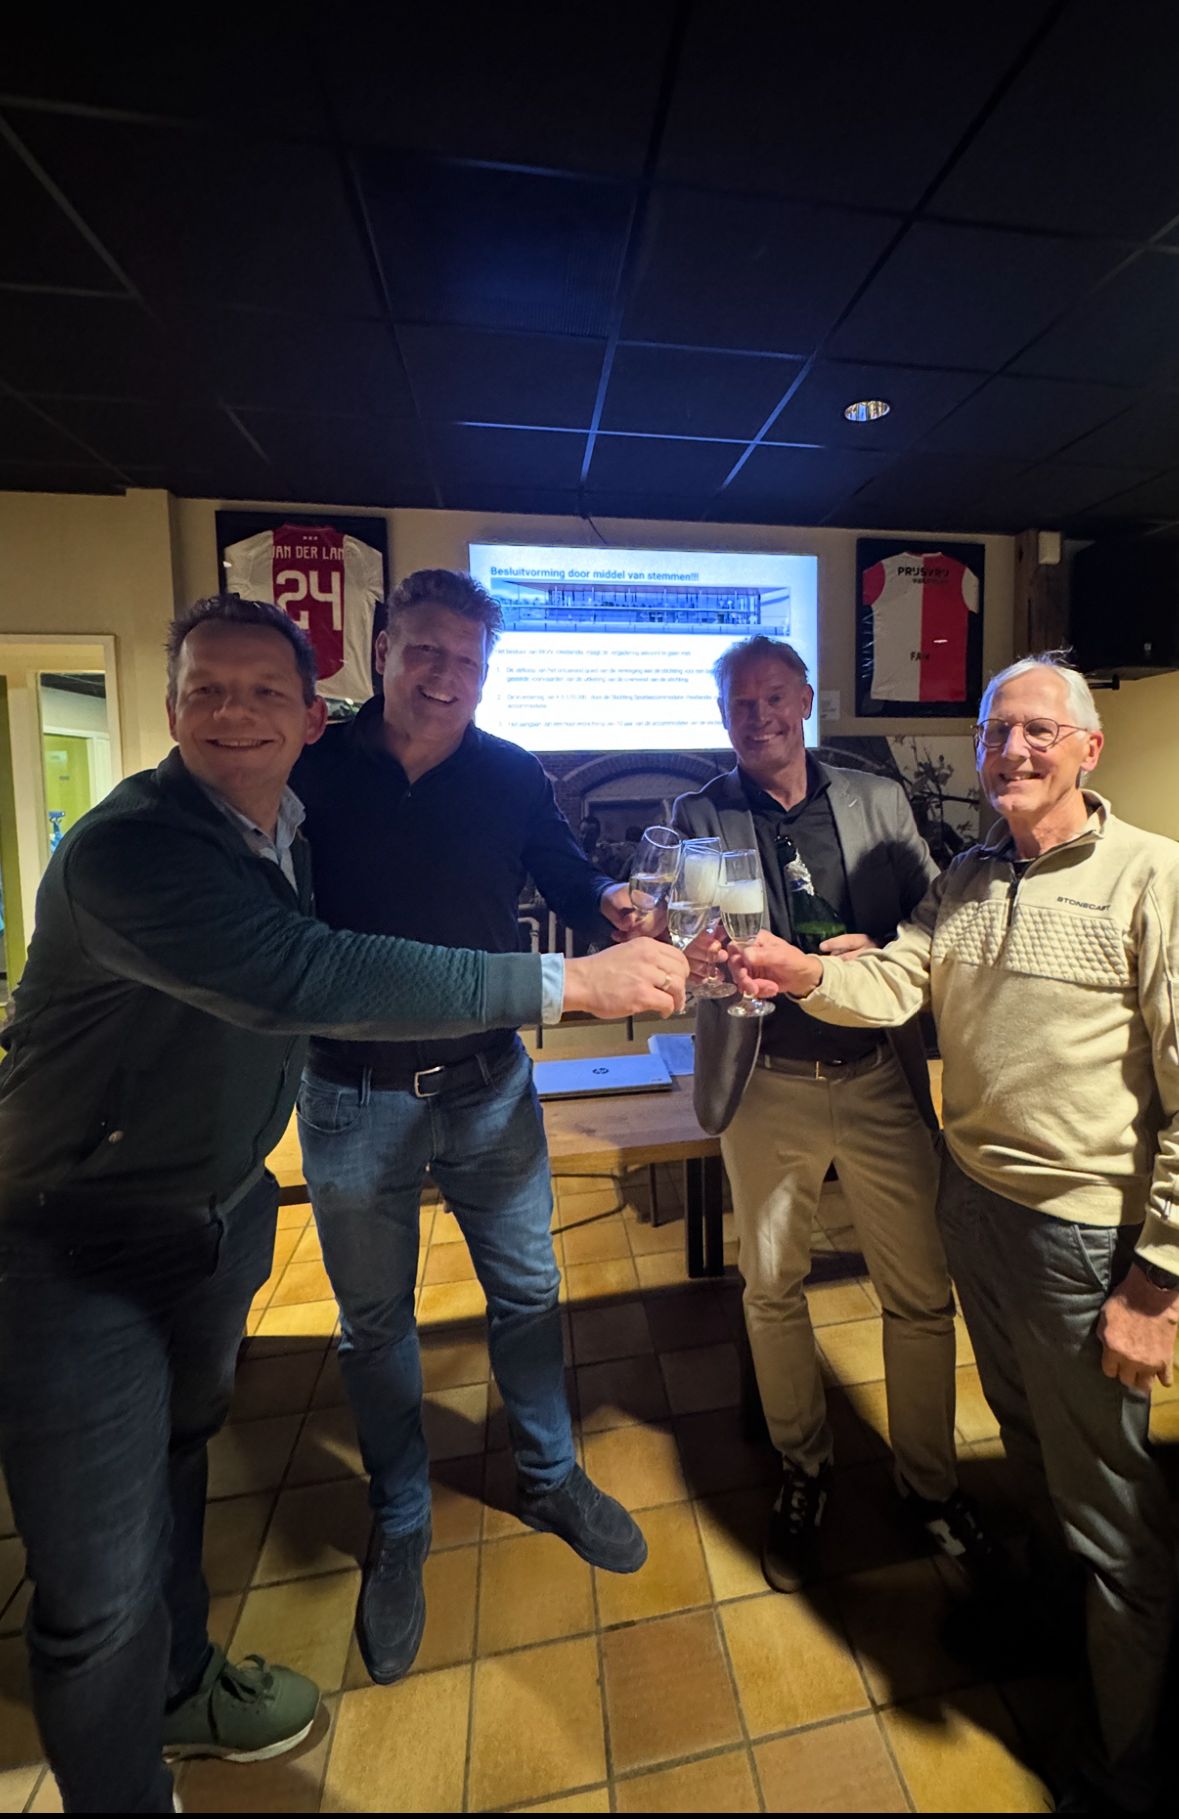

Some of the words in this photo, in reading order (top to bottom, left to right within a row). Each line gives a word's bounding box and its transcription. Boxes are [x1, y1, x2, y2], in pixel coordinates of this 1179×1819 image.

[296, 545, 318, 560] DER
[490, 566, 565, 580] Besluitvorming
[568, 569, 590, 579] door
[593, 569, 626, 580] middel
[627, 571, 646, 580] van
[647, 571, 699, 582] stemmen!!!
[275, 569, 342, 631] 24
